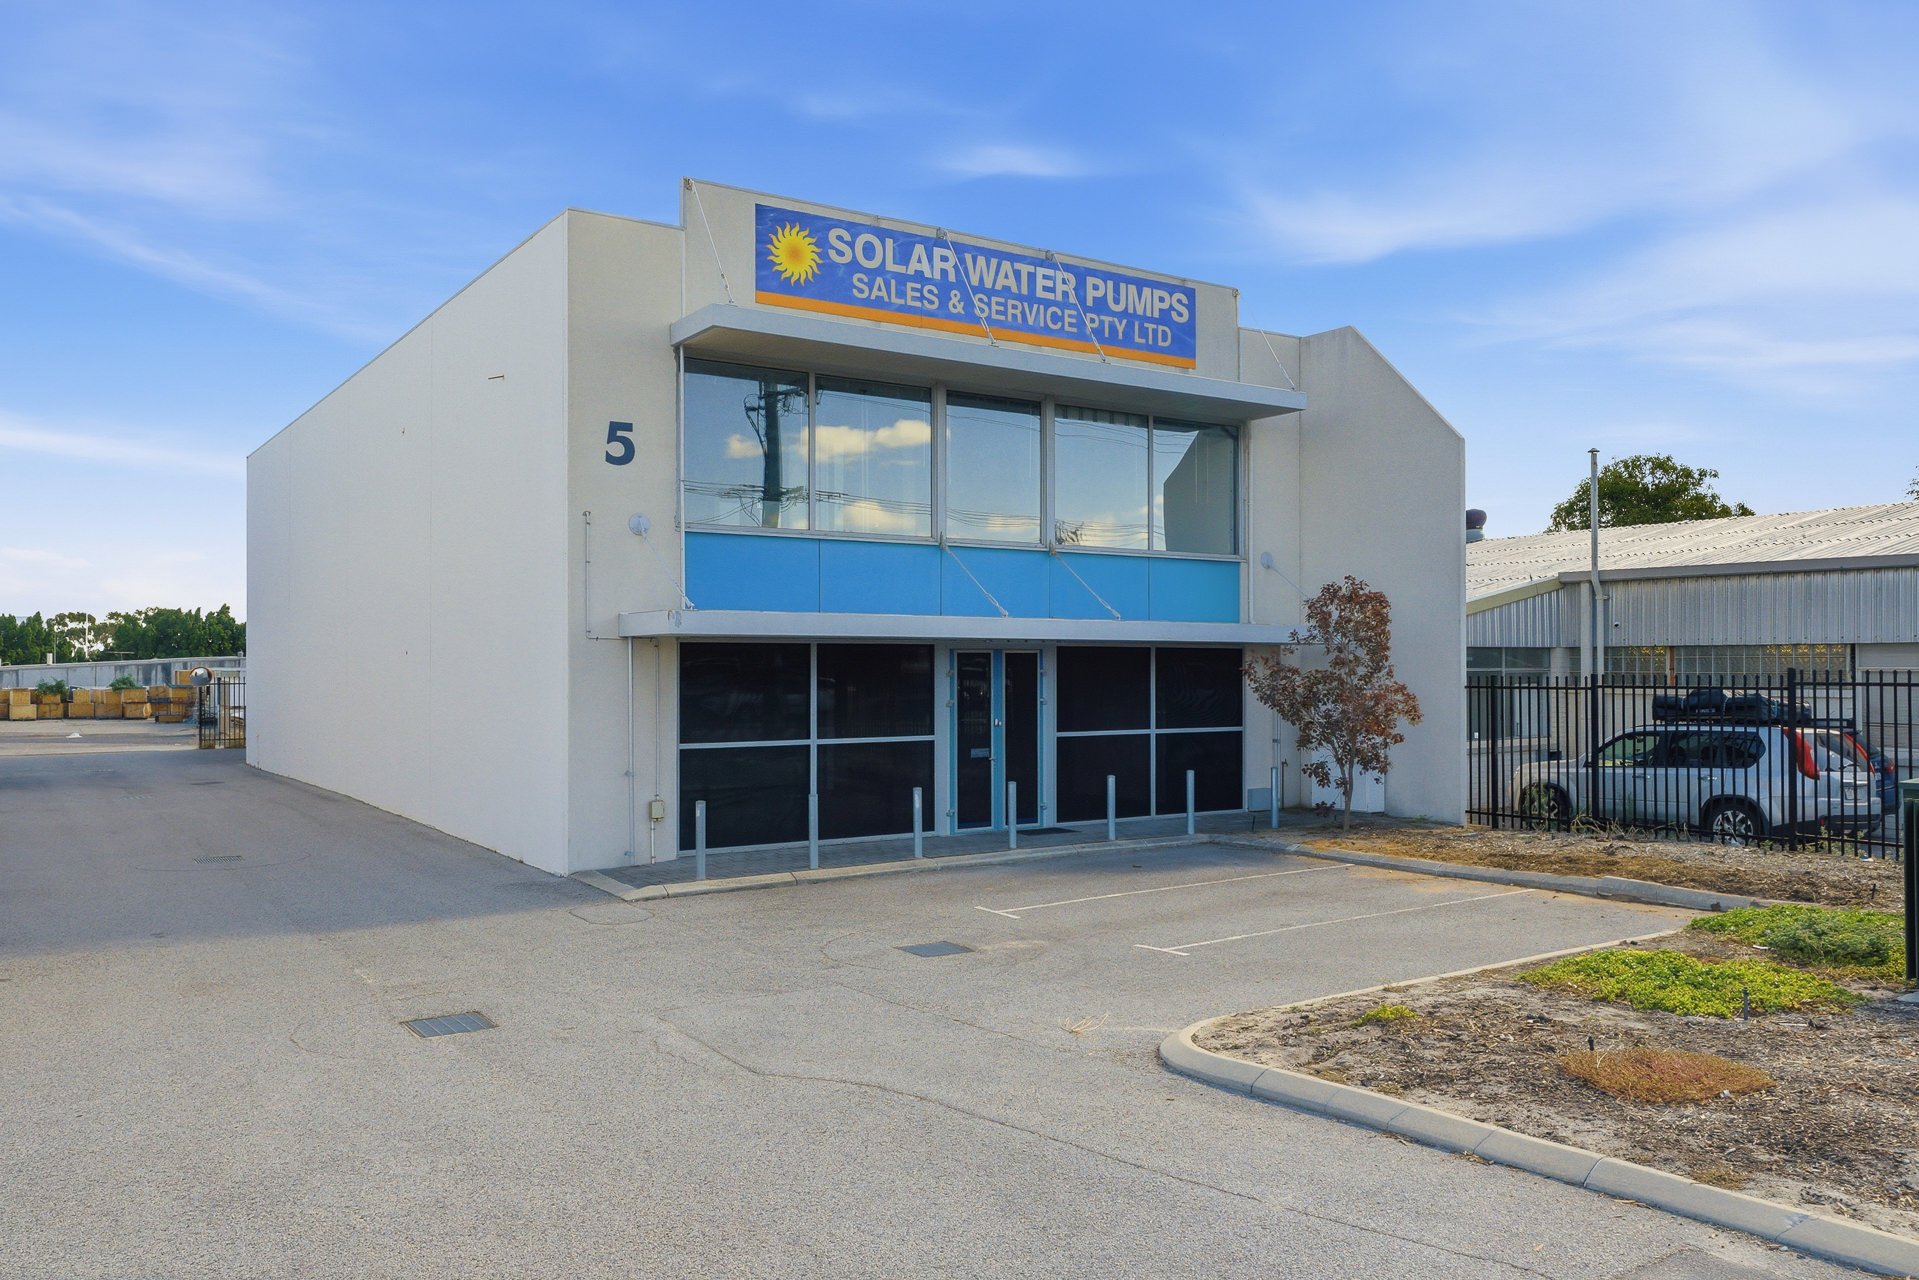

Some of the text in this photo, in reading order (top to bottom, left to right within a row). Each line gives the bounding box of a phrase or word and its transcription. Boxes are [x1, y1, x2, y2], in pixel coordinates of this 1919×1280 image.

[827, 228, 1189, 323] SOLAR WATER PUMPS
[852, 273, 1172, 347] SALES & SERVICE PTY LTD
[605, 421, 635, 466] 5
